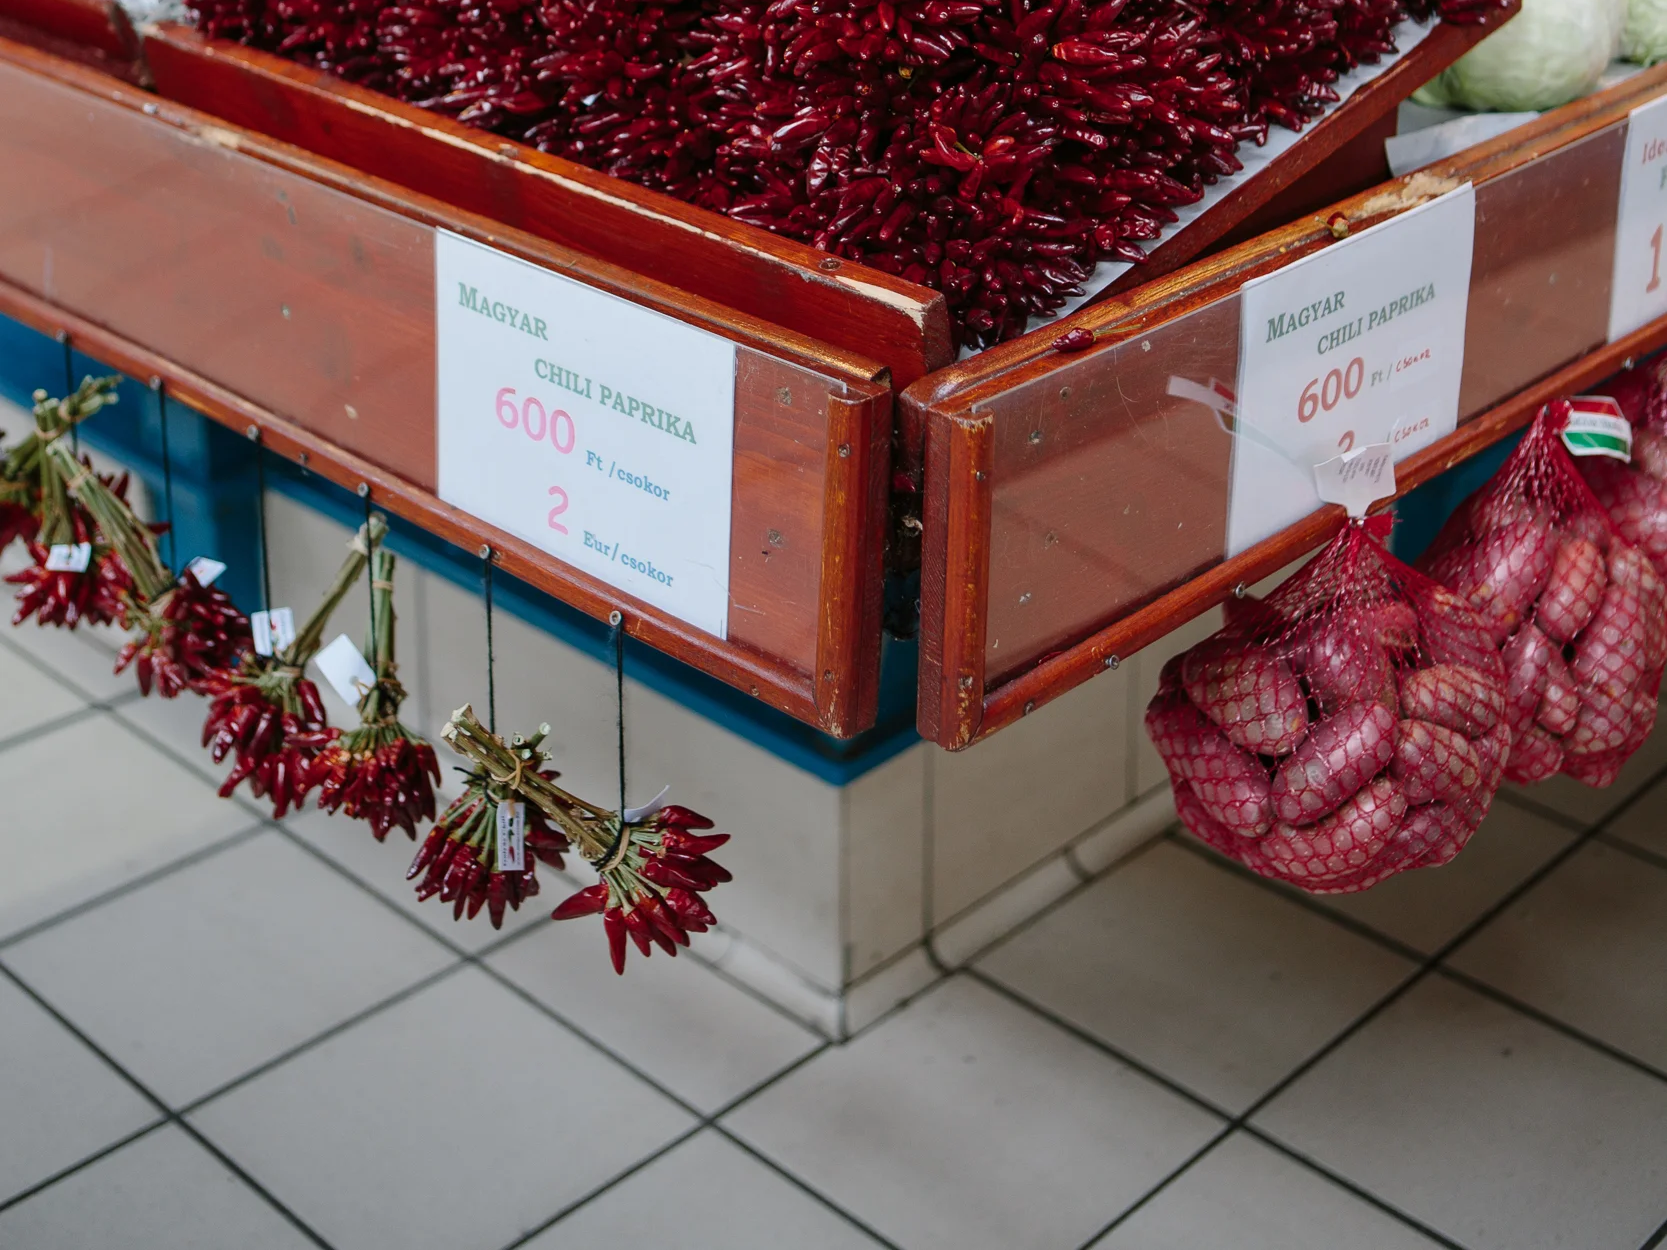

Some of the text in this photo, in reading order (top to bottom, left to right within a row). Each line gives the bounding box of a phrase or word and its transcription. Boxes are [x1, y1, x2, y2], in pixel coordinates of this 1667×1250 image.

[1642, 138, 1667, 165] Ide
[457, 281, 549, 342] MAGYAR
[1265, 290, 1346, 344] MAGYAR
[1317, 282, 1436, 356] CHILI PAPRIKA
[534, 357, 698, 445] CHILI PAPRIKA
[1297, 356, 1365, 424] 600
[1370, 370, 1383, 387] Ft
[495, 387, 576, 455] 600
[586, 449, 604, 472] Ft
[547, 485, 569, 536] 2
